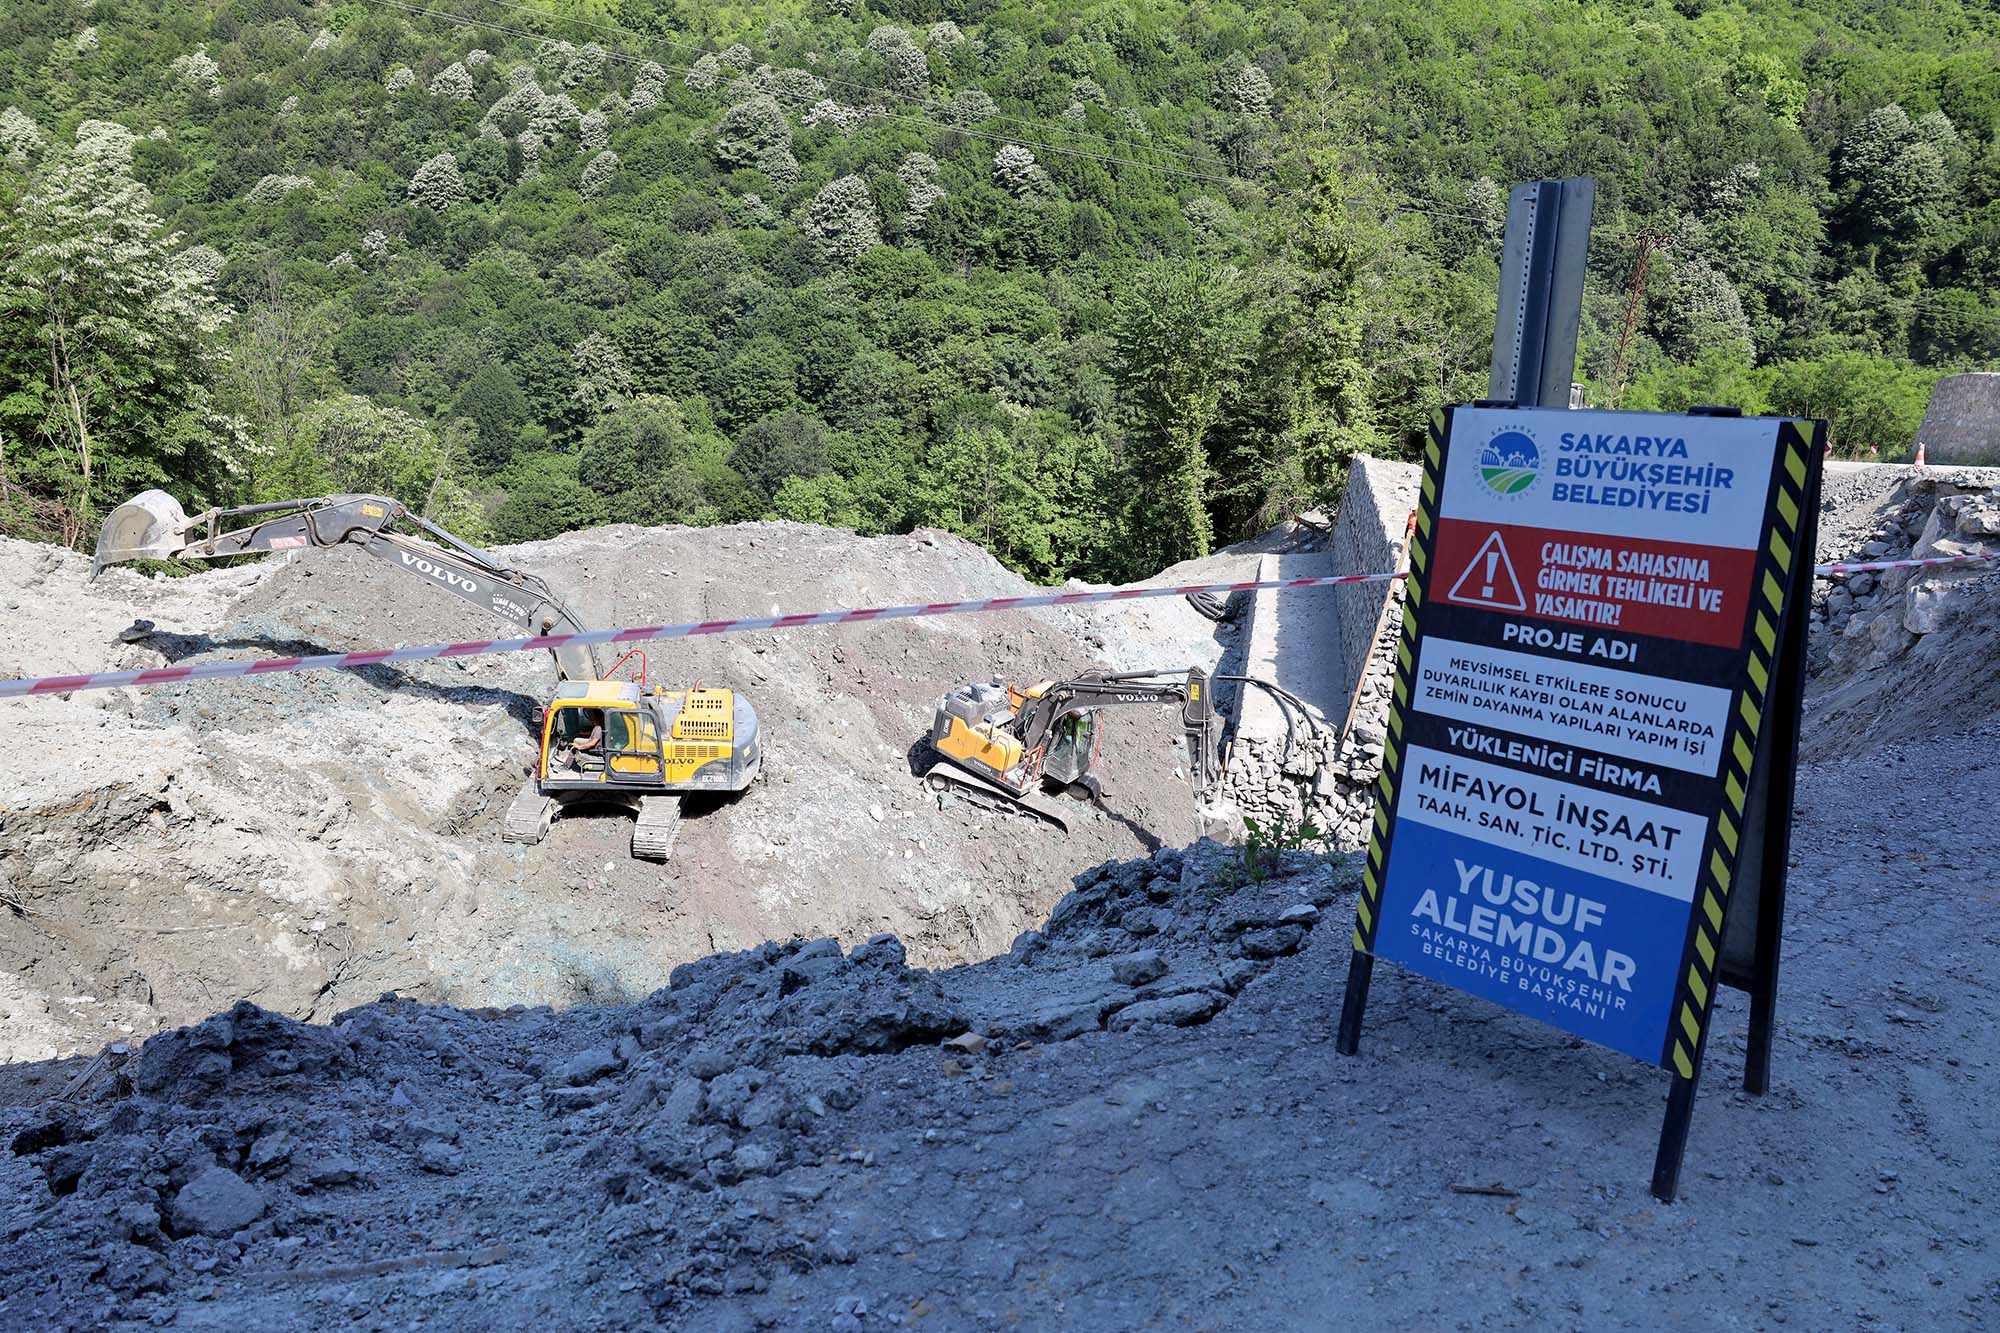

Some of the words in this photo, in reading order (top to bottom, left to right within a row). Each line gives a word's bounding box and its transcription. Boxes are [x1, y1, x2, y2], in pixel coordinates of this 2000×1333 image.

[1555, 455, 1734, 488] BÜYÜKŞEHİR
[1559, 432, 1688, 459] SAKARYA
[1552, 482, 1711, 514] BELEDİYESİ
[399, 550, 477, 593] VOLVO
[1537, 567, 1601, 597] GİRMEK
[1605, 577, 1696, 610] TEHLİKELİ
[1699, 588, 1723, 613] VE
[1541, 542, 1612, 571] ÇALIŞMA
[1615, 550, 1709, 582] SAHASINA
[1535, 593, 1622, 626] YASAKTIR!
[1503, 622, 1583, 653] PROJE
[1589, 639, 1638, 663] ADI
[1116, 693, 1159, 702] VOLVO
[1423, 669, 1505, 696] DUYARLILIK
[1510, 686, 1553, 705] KAYBI
[1559, 696, 1603, 715] OLAN
[1608, 706, 1714, 738] ALANLARDA
[1450, 657, 1530, 683] MEVSİMSEL
[1535, 674, 1610, 698] ETKİLERE
[1614, 689, 1686, 713] SONUCU
[1426, 686, 1469, 705] ZEMİN
[1473, 696, 1544, 721] DAYANMA
[1549, 711, 1621, 737] YAPILARI
[1627, 727, 1678, 749] YAPIM
[1683, 737, 1706, 756] İŞİ
[1447, 726, 1573, 774] YÜKLENİCİ
[1579, 754, 1662, 796] FİRMA
[1419, 763, 1545, 817] MİFAYOL
[1555, 793, 1681, 852] İNŞAAT
[1417, 794, 1471, 823] TAAH.
[1478, 810, 1524, 839] SAN.
[1531, 824, 1571, 851] TİC.
[1579, 839, 1623, 867] LTD.
[1632, 853, 1673, 880] ŞTİ.
[1454, 857, 1607, 933] YUSUF
[1411, 888, 1637, 992] ALEMDAR
[1411, 924, 1491, 962] SAKARYA
[1501, 955, 1627, 1011] BÜYÜKŞEHİR
[1422, 942, 1510, 984] BELEDİYE
[1518, 978, 1606, 1020] BAŞKANI
